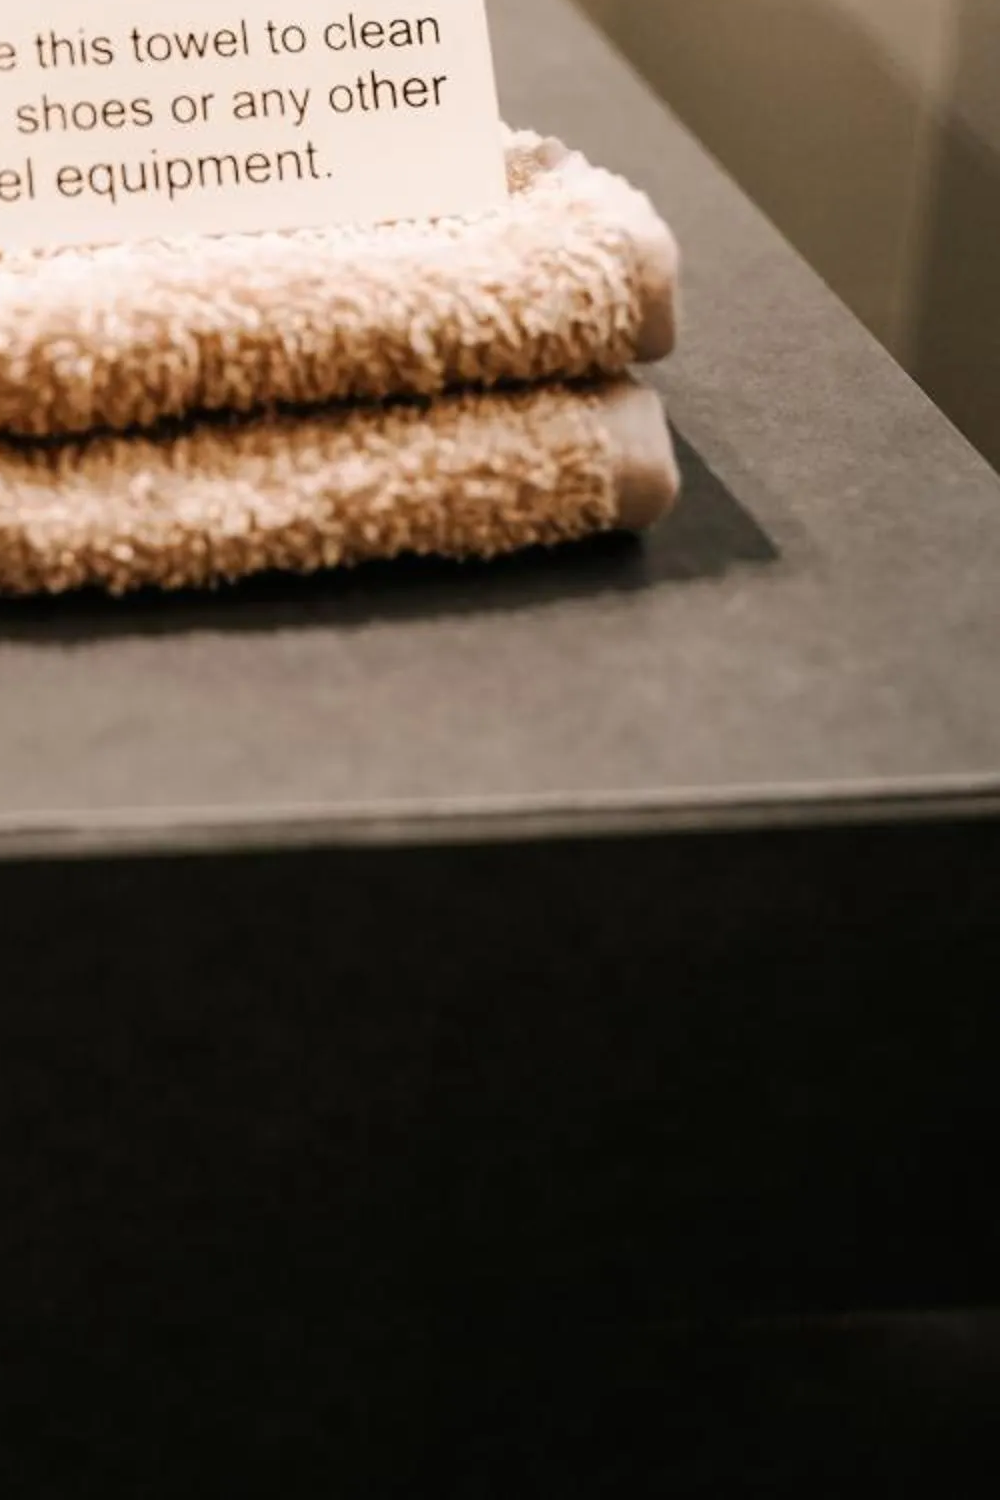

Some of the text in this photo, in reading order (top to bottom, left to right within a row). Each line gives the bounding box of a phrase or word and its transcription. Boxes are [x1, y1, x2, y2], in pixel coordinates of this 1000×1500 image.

[34, 30, 115, 70] this
[130, 19, 250, 63] towel
[264, 20, 307, 55] to
[323, 12, 441, 51] clean
[16, 93, 154, 135] shoes
[170, 92, 215, 124] or
[232, 87, 311, 124] any
[328, 69, 448, 113] other
[55, 140, 333, 205] equipment.
